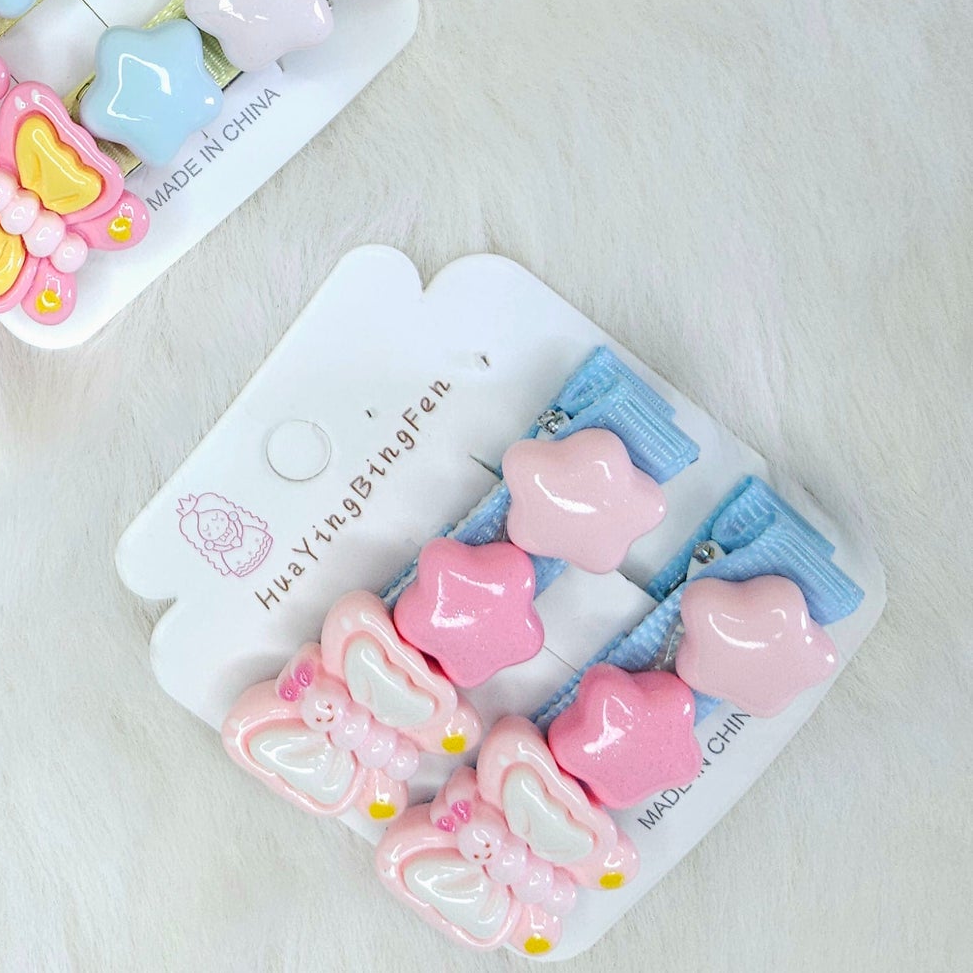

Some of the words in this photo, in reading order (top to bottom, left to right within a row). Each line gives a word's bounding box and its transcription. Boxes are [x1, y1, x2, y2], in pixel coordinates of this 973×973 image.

[145, 157, 203, 211] MADE
[199, 138, 224, 163] IN
[222, 88, 281, 142] CHINA
[254, 379, 451, 610] HuaYingBingFen
[707, 712, 752, 755] CHIN
